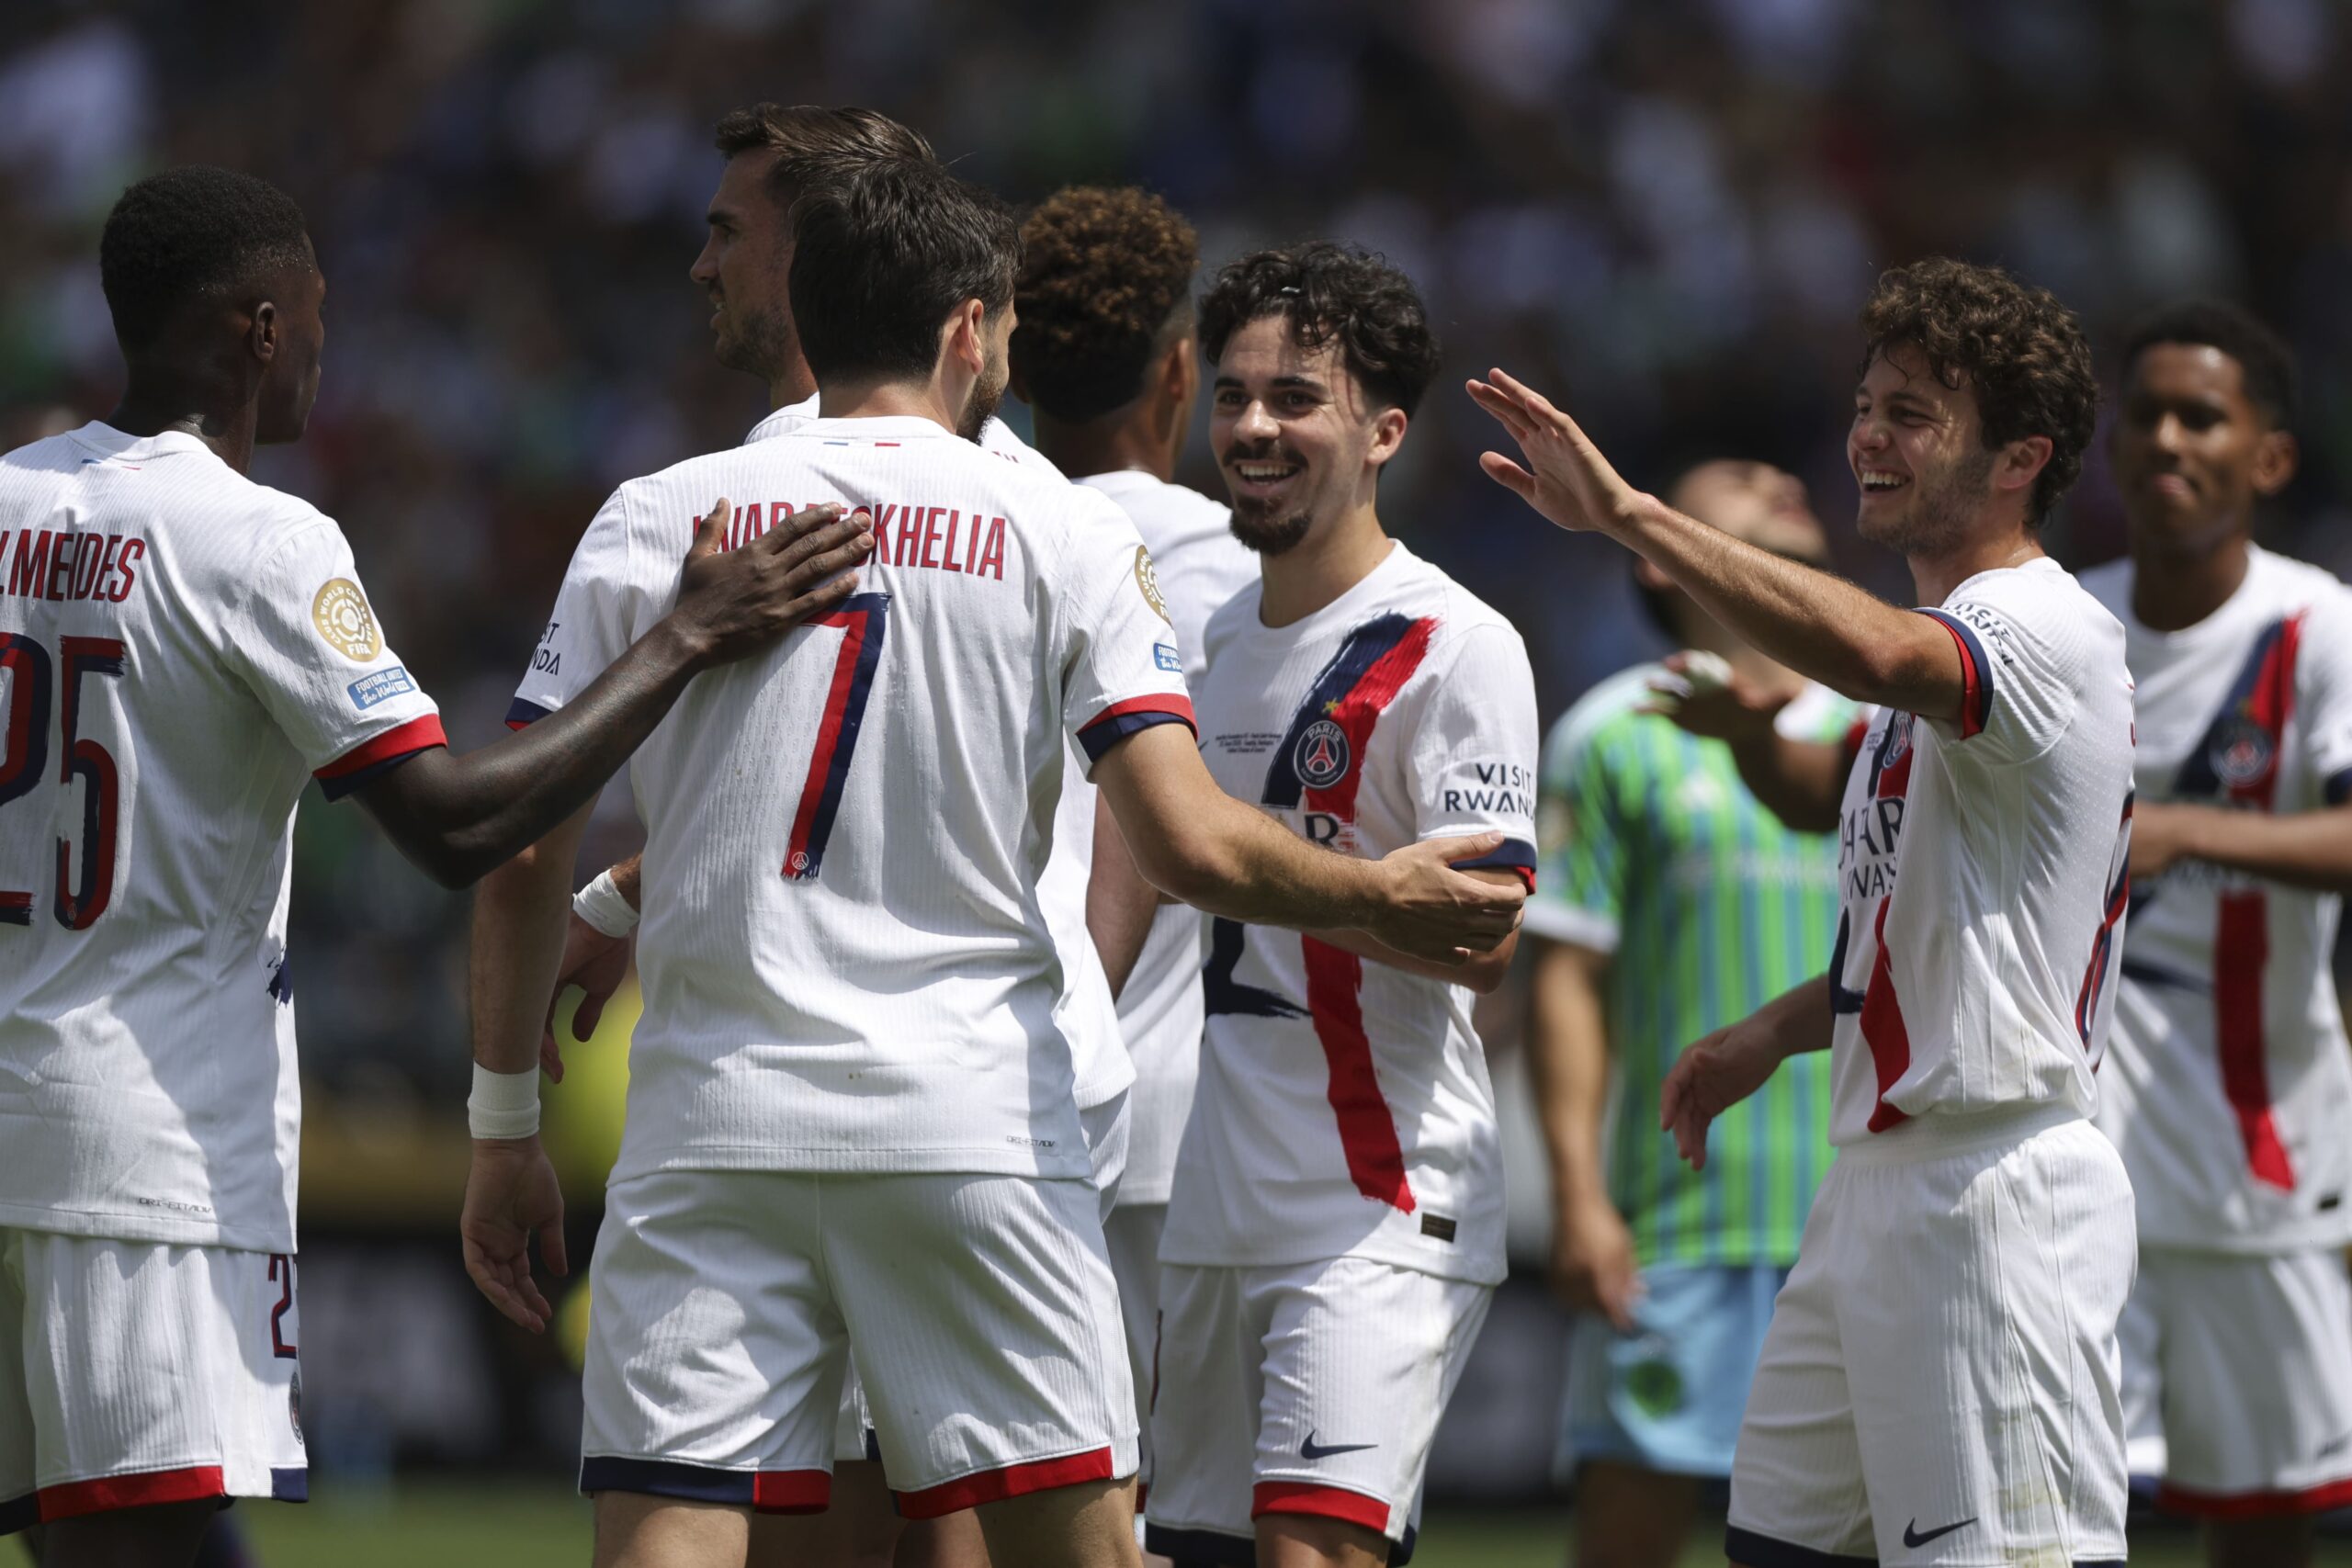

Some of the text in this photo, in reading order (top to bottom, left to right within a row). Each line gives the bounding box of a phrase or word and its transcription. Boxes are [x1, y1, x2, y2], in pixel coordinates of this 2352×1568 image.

[320, 586, 345, 615] WORLD
[780, 591, 892, 881] 7
[1307, 723, 1343, 743] PARIS
[0, 631, 128, 931] 25
[1475, 762, 1532, 795] VISIT
[1444, 789, 1534, 821] RWAN
